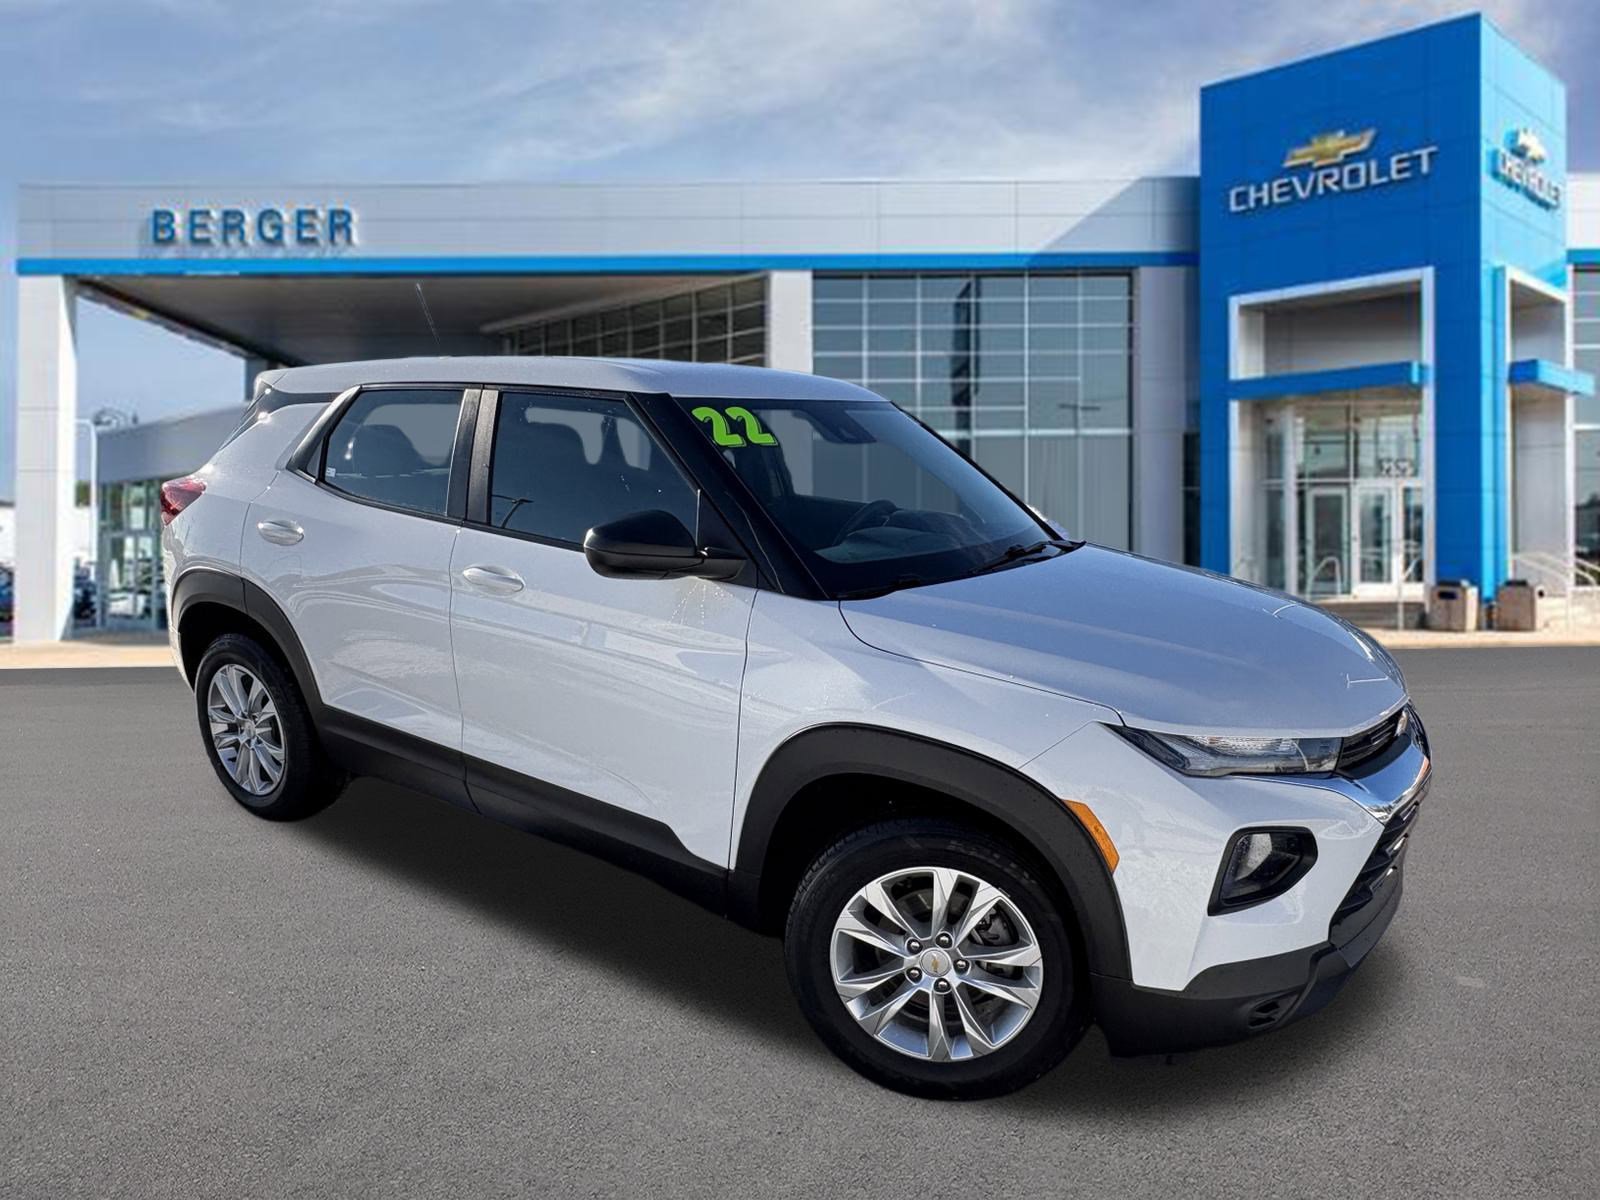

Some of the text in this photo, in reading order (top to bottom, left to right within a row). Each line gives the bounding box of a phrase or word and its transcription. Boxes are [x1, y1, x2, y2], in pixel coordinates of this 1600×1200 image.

[1229, 146, 1438, 212] CHEVROLET
[152, 208, 354, 246] BERGER
[691, 406, 779, 448] 22
